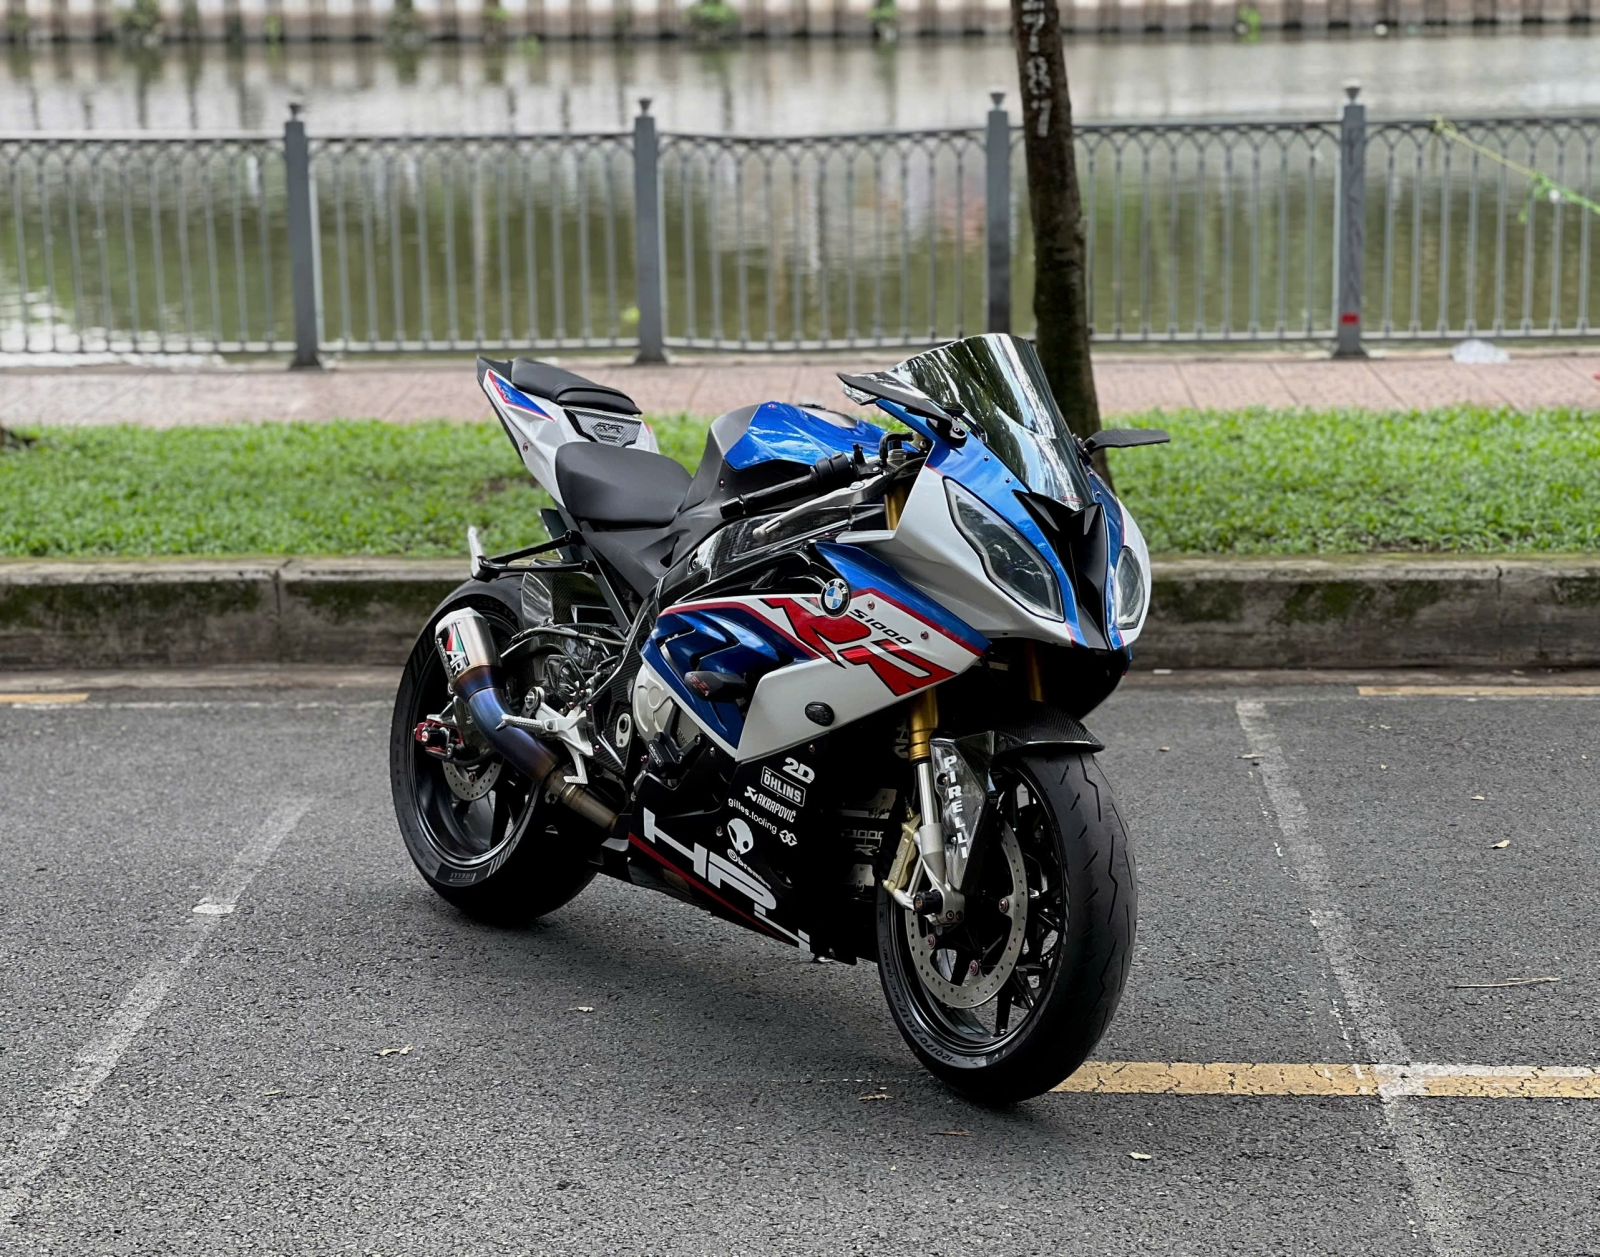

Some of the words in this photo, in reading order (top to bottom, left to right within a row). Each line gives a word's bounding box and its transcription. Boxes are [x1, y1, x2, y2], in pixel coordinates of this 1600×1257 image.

[849, 608, 912, 645] S1000
[763, 769, 802, 803] ÖHLINS
[782, 756, 815, 784] 2D
[727, 797, 778, 835] gilles.tooling
[943, 755, 968, 859] PIRELLI
[919, 1037, 954, 1063] 120/70
